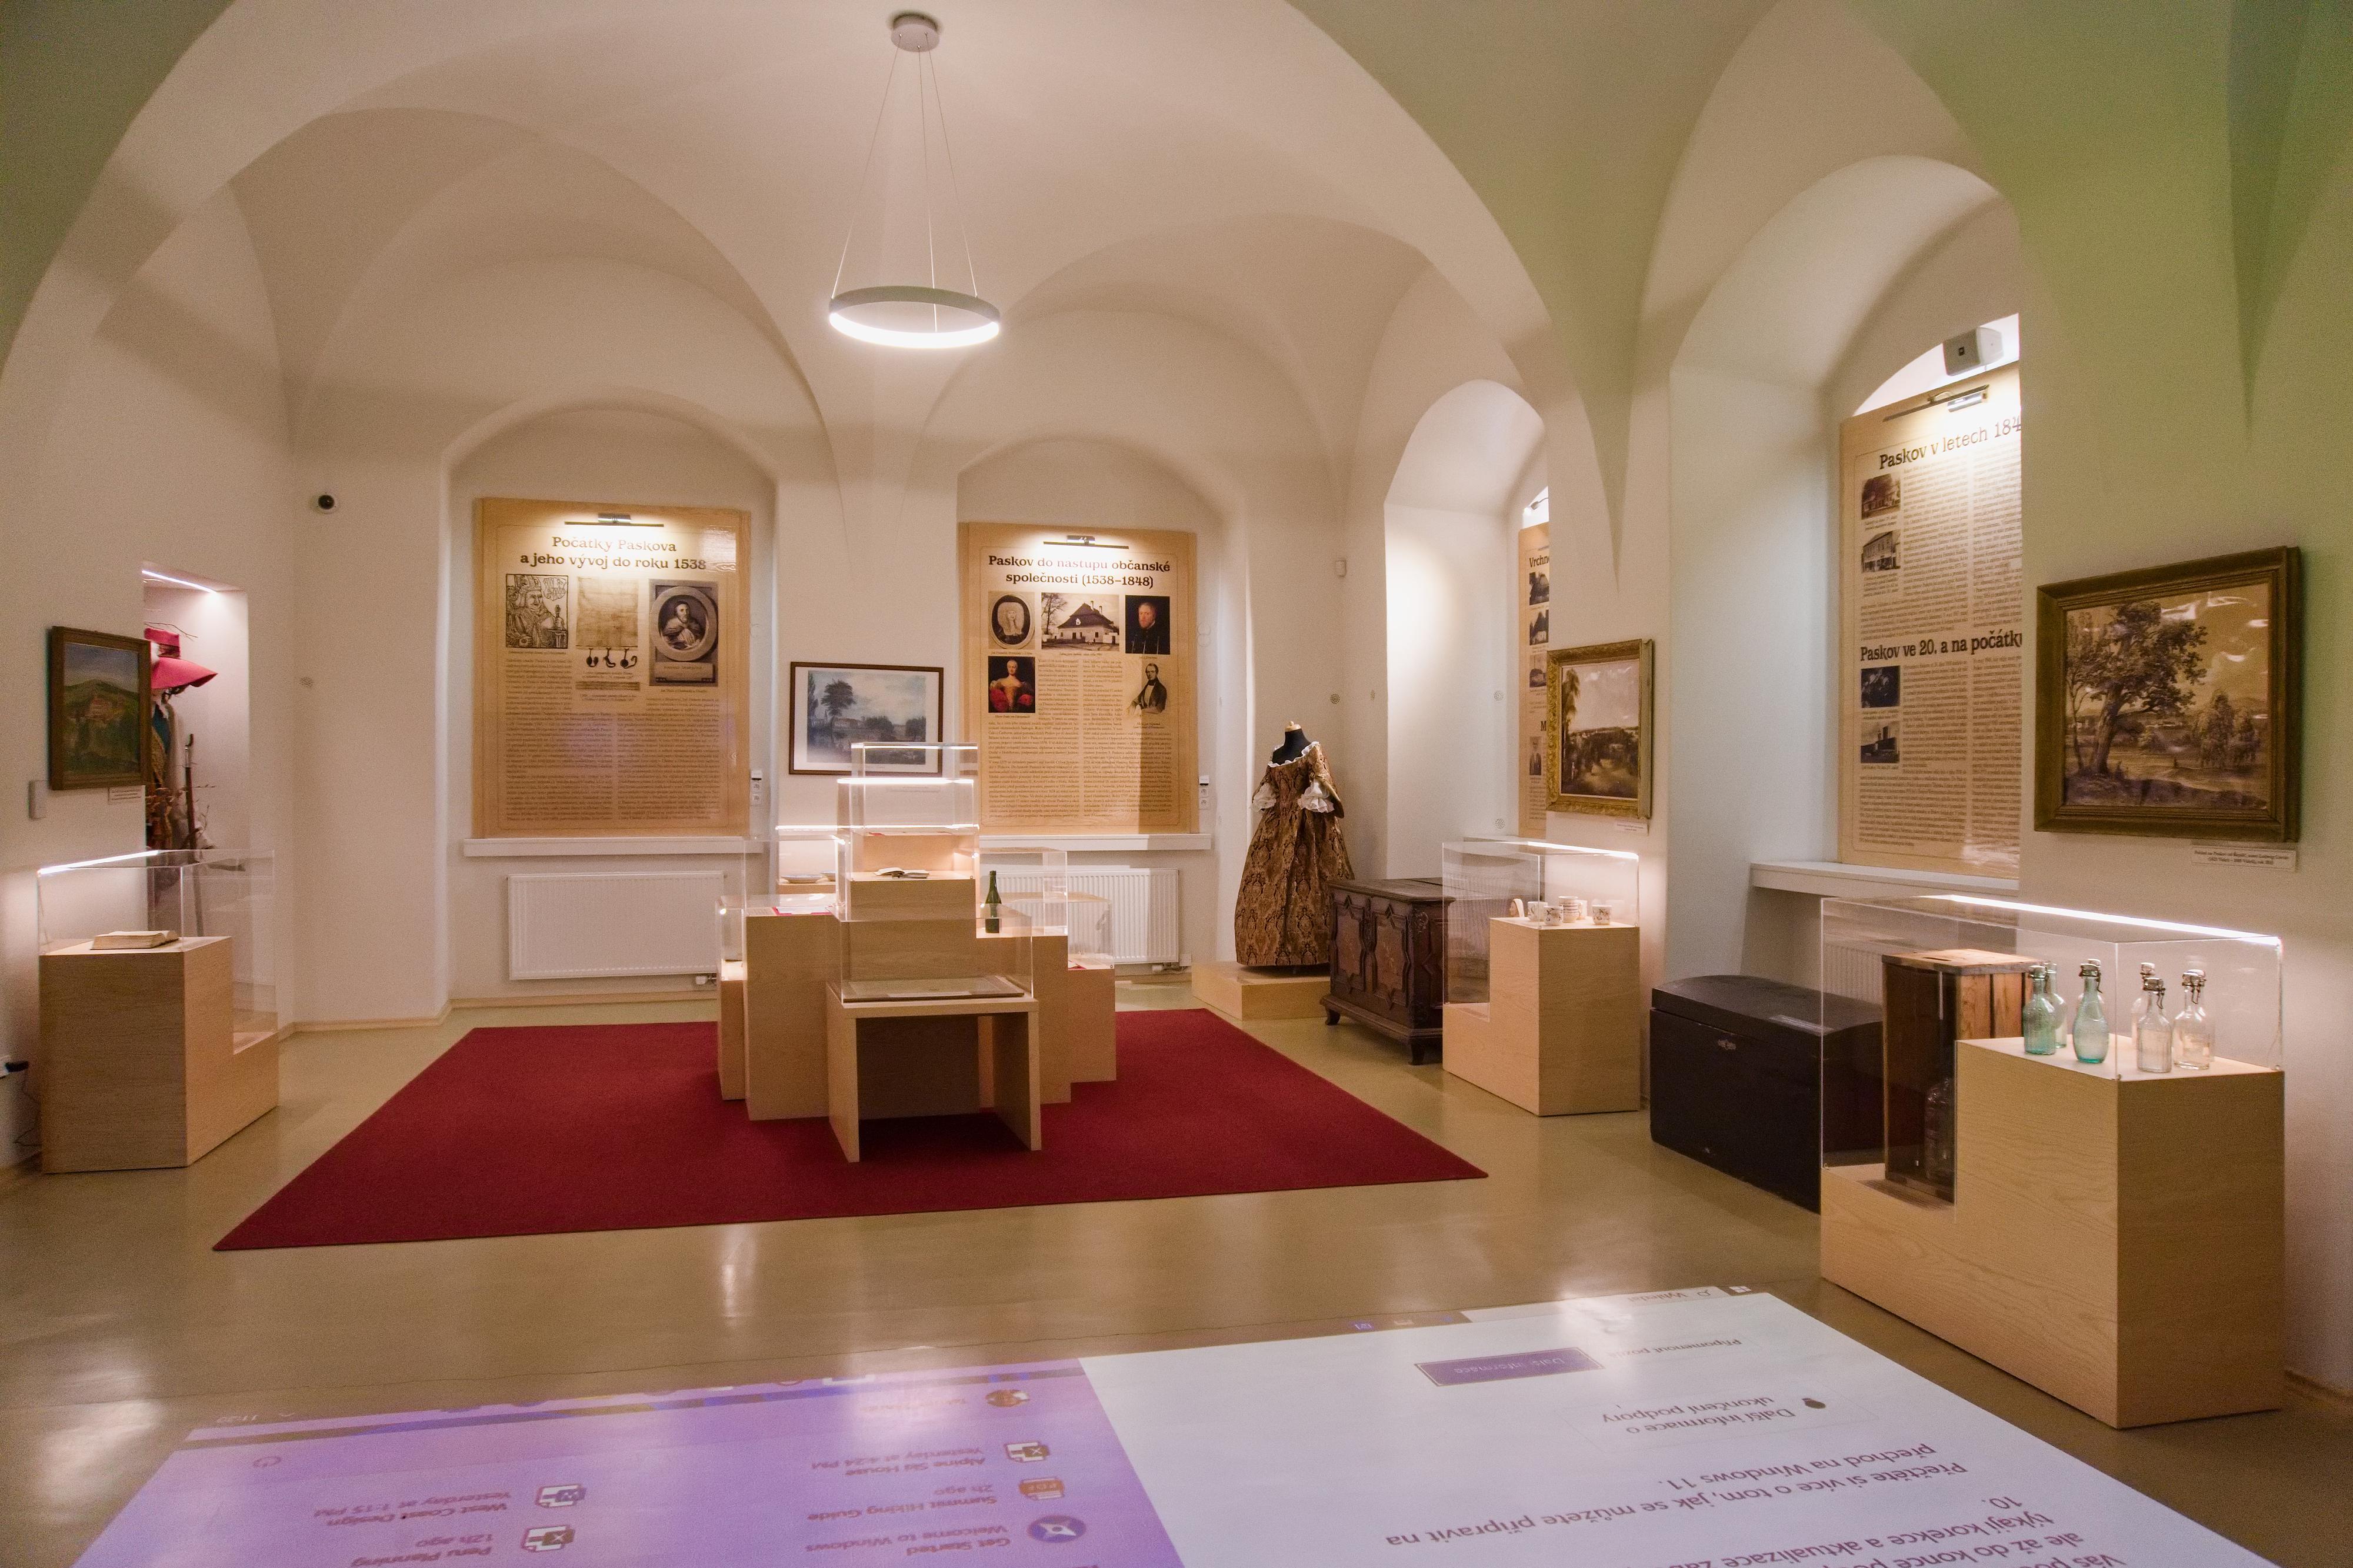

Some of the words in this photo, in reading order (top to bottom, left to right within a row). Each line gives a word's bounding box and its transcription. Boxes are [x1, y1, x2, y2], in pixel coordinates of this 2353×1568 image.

[1879, 446, 1927, 469] Paskov
[1931, 442, 1939, 455] v
[1942, 427, 1988, 452] letech
[619, 539, 676, 552] Paskova
[520, 555, 529, 563] a
[530, 553, 565, 567] jeho
[569, 553, 608, 569] vývoj
[613, 557, 631, 567] do
[635, 558, 668, 569] roku
[674, 559, 706, 570] 1538
[988, 555, 1034, 567] Paskov
[1037, 558, 1053, 568] do
[1111, 559, 1171, 572] občanské
[1529, 555, 1549, 568] Vrchn
[1006, 572, 1078, 584] společnosti
[1860, 644, 1900, 662] Paskov
[1903, 643, 1916, 656] ve
[1919, 639, 1937, 655] 20.
[1941, 640, 1948, 653] a
[1951, 638, 1968, 652] na
[1654, 1339, 1742, 1354] Připomenout
[1687, 1396, 1774, 1414] ukončení
[1601, 1405, 1685, 1424] podpory
[1745, 1408, 1795, 1422] Další
[1626, 1426, 1640, 1434] o
[1644, 1414, 1742, 1434] informace
[934, 1457, 985, 1467] Alpine
[1844, 1443, 1937, 1468] přechod
[845, 1466, 899, 1476] House
[1809, 1458, 1842, 1470] na
[1700, 1463, 1812, 1486] Windows
[1847, 1474, 1868, 1487] si
[1869, 1463, 1968, 1483] Přečtěte
[1658, 1476, 1697, 1490] 11.
[1775, 1485, 1791, 1494] o
[1797, 1478, 1846, 1493] více
[929, 1496, 997, 1509] Summit
[1671, 1492, 1714, 1510] jak
[1712, 1488, 1772, 1503] tom,
[1982, 1496, 2022, 1510] 10.
[461, 1503, 507, 1514] West
[866, 1503, 924, 1515] Hiking
[1542, 1504, 1636, 1523] můžete
[1639, 1500, 1669, 1513] se
[326, 1514, 395, 1526] Design
[807, 1510, 861, 1522] Guide
[922, 1526, 1008, 1540] Welcome
[1425, 1514, 1535, 1543] připravit
[1887, 1523, 1989, 1546] korekce
[806, 1537, 892, 1553] Windows
[978, 1538, 1010, 1548] Get
[1386, 1533, 1421, 1547] na
[1865, 1538, 1884, 1548] a
[2009, 1537, 2043, 1554] až
[2044, 1532, 2083, 1547] ale
[448, 1546, 492, 1557] Peru
[906, 1542, 972, 1557] Started
[1721, 1541, 1862, 1568] aktualizace
[1974, 1542, 2009, 1557] do
[351, 1552, 441, 1568] Planning
[1893, 1550, 1977, 1568] konce
